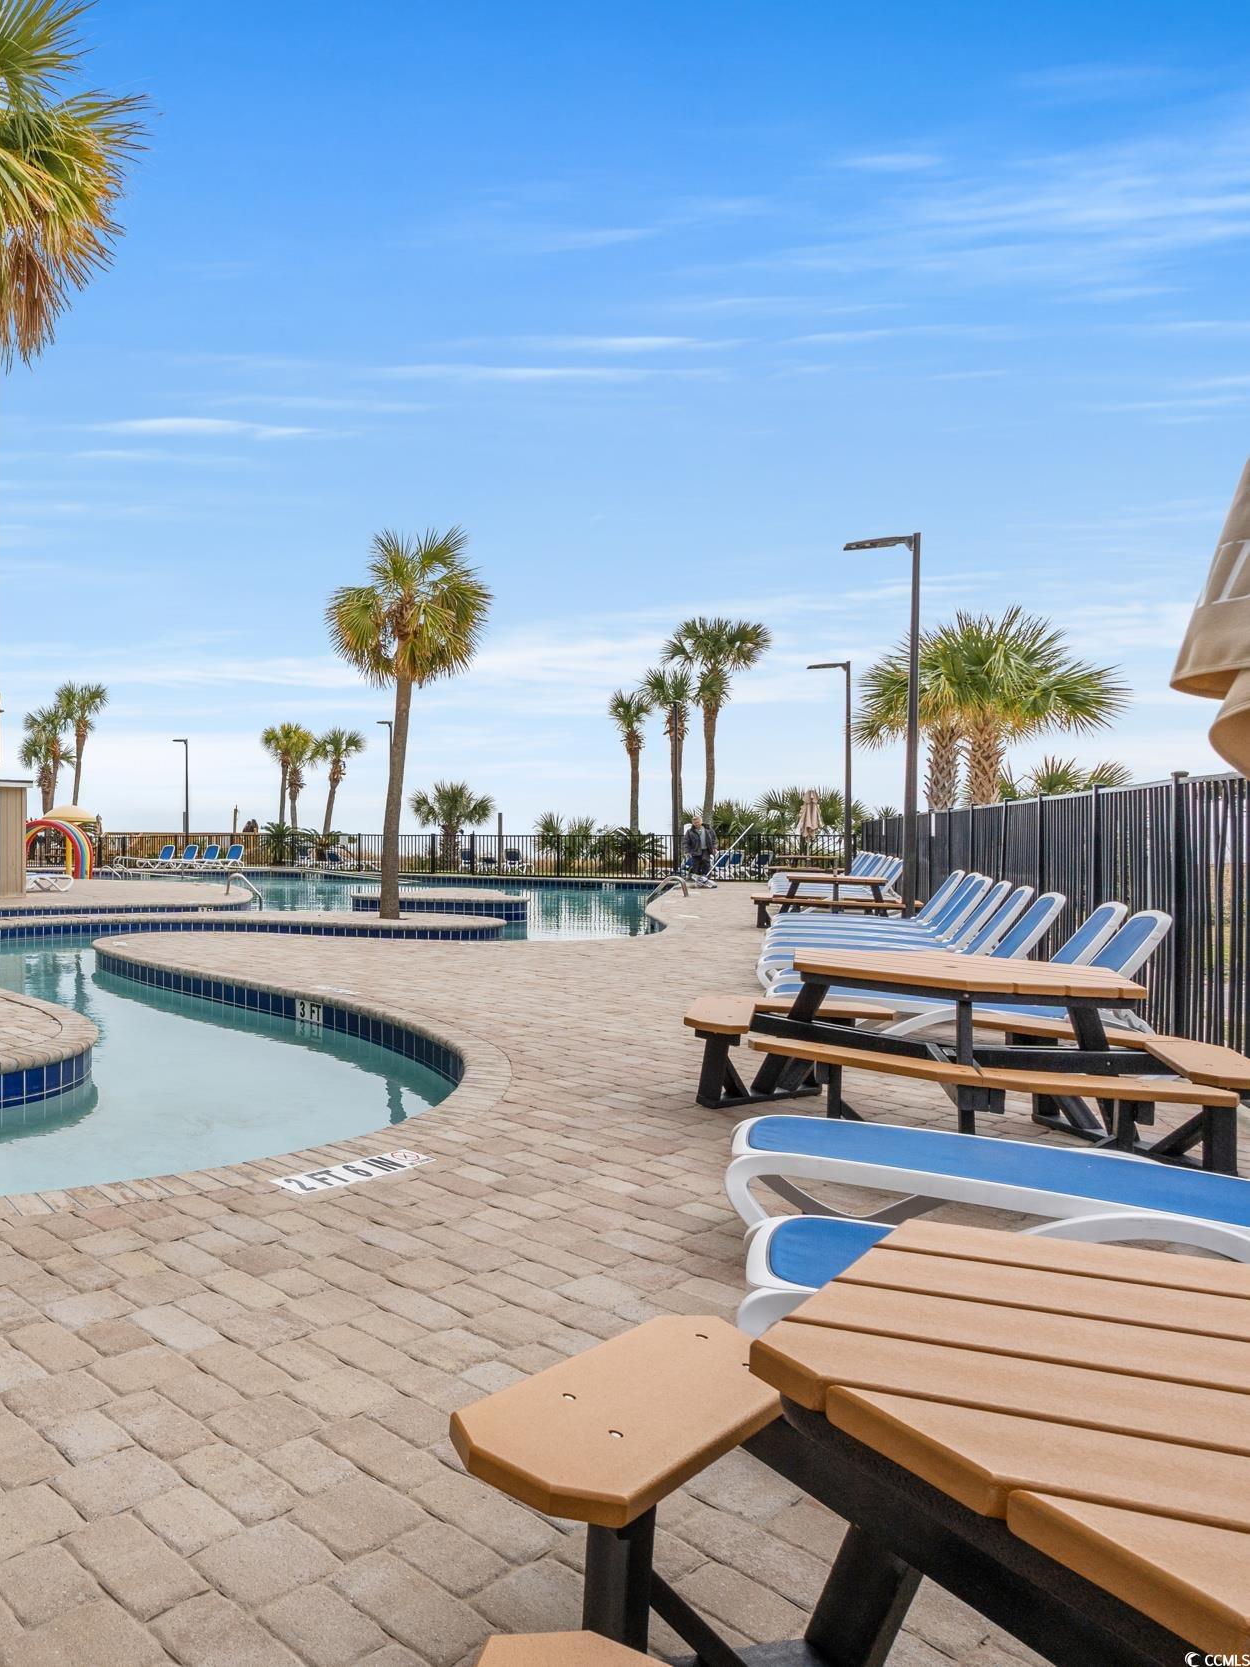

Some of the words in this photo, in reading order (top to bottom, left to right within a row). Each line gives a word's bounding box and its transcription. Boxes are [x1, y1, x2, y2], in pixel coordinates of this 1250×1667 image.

[300, 1001, 306, 1018] 3
[310, 1002, 322, 1022] FT
[284, 1178, 317, 1192] 2
[304, 1169, 350, 1186] FT
[342, 1164, 373, 1178] 6
[362, 1156, 406, 1172] IN
